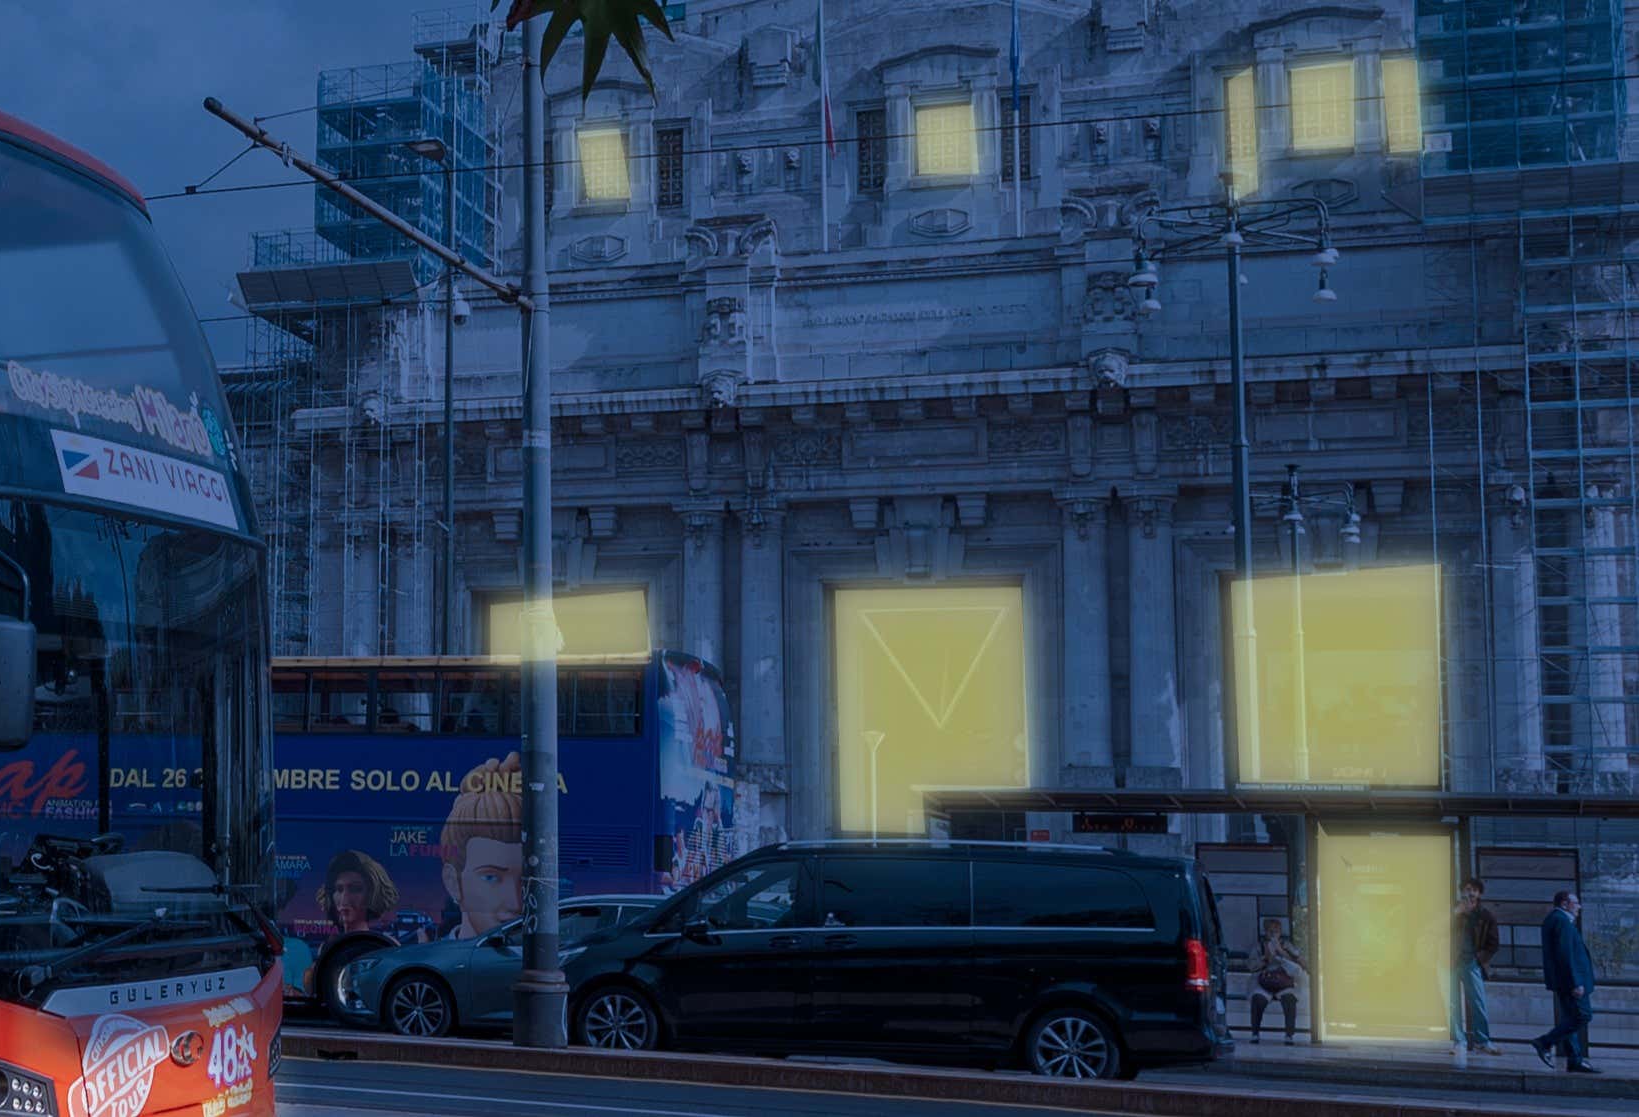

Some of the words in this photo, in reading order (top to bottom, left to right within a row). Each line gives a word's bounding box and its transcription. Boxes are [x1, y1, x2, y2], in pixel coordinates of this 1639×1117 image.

[103, 447, 159, 485] ZANI
[162, 461, 229, 504] VIAGGI
[110, 768, 156, 788] DAL
[161, 768, 188, 788] 26
[350, 769, 421, 791] SOLO
[425, 771, 460, 792] AL
[466, 769, 569, 794] CINEA
[390, 831, 427, 845] JAKE
[80, 1031, 166, 1115] OFFICIAL
[207, 1026, 237, 1089] 48
